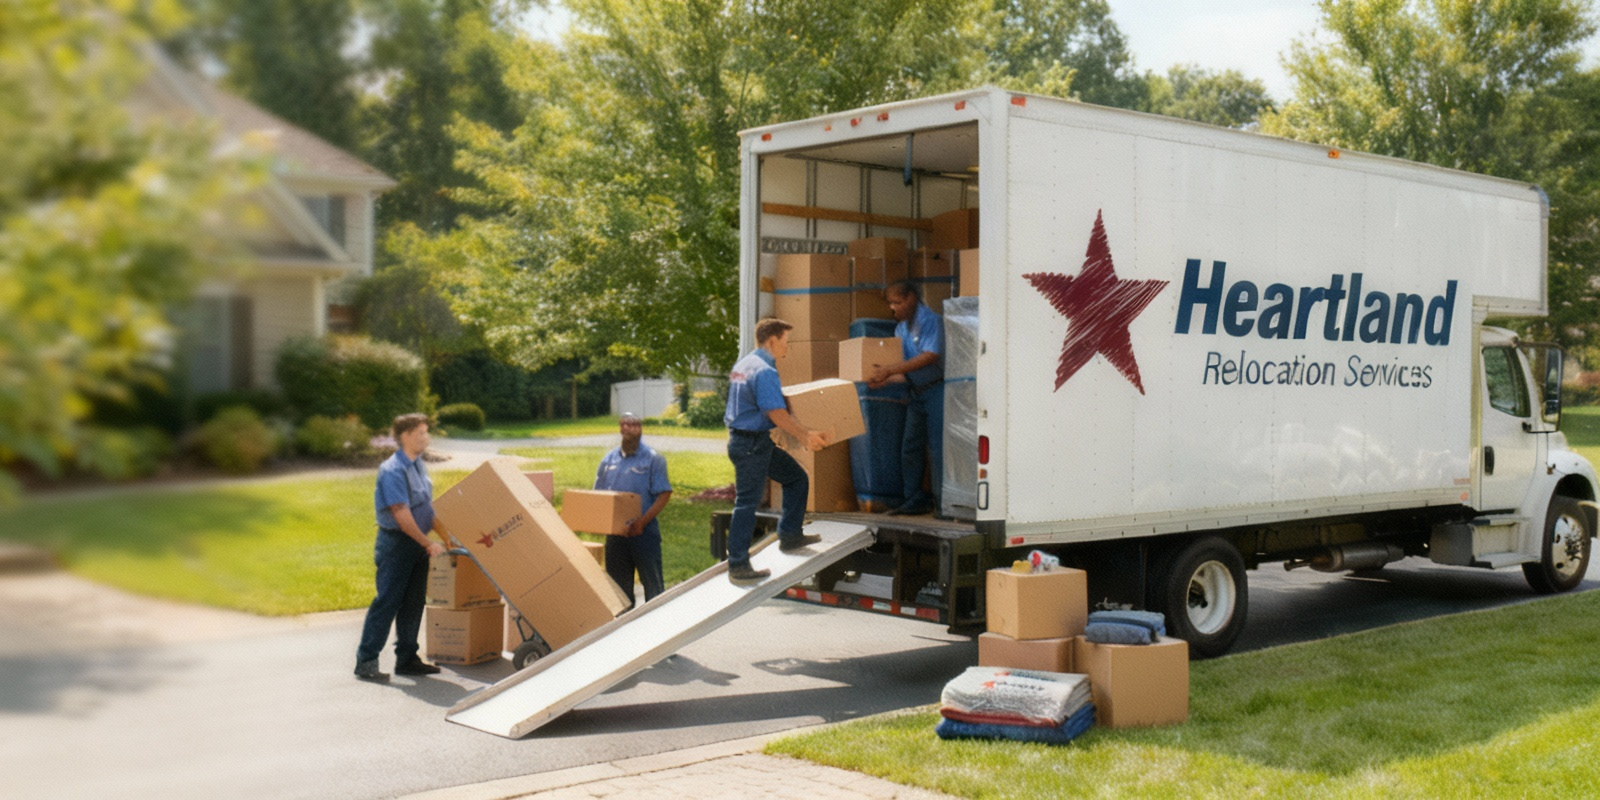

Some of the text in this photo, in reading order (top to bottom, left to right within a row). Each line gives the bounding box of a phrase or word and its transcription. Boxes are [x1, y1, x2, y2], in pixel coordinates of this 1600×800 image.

[1174, 258, 1458, 345] Heartland
[1203, 350, 1432, 388] Relocation Services
